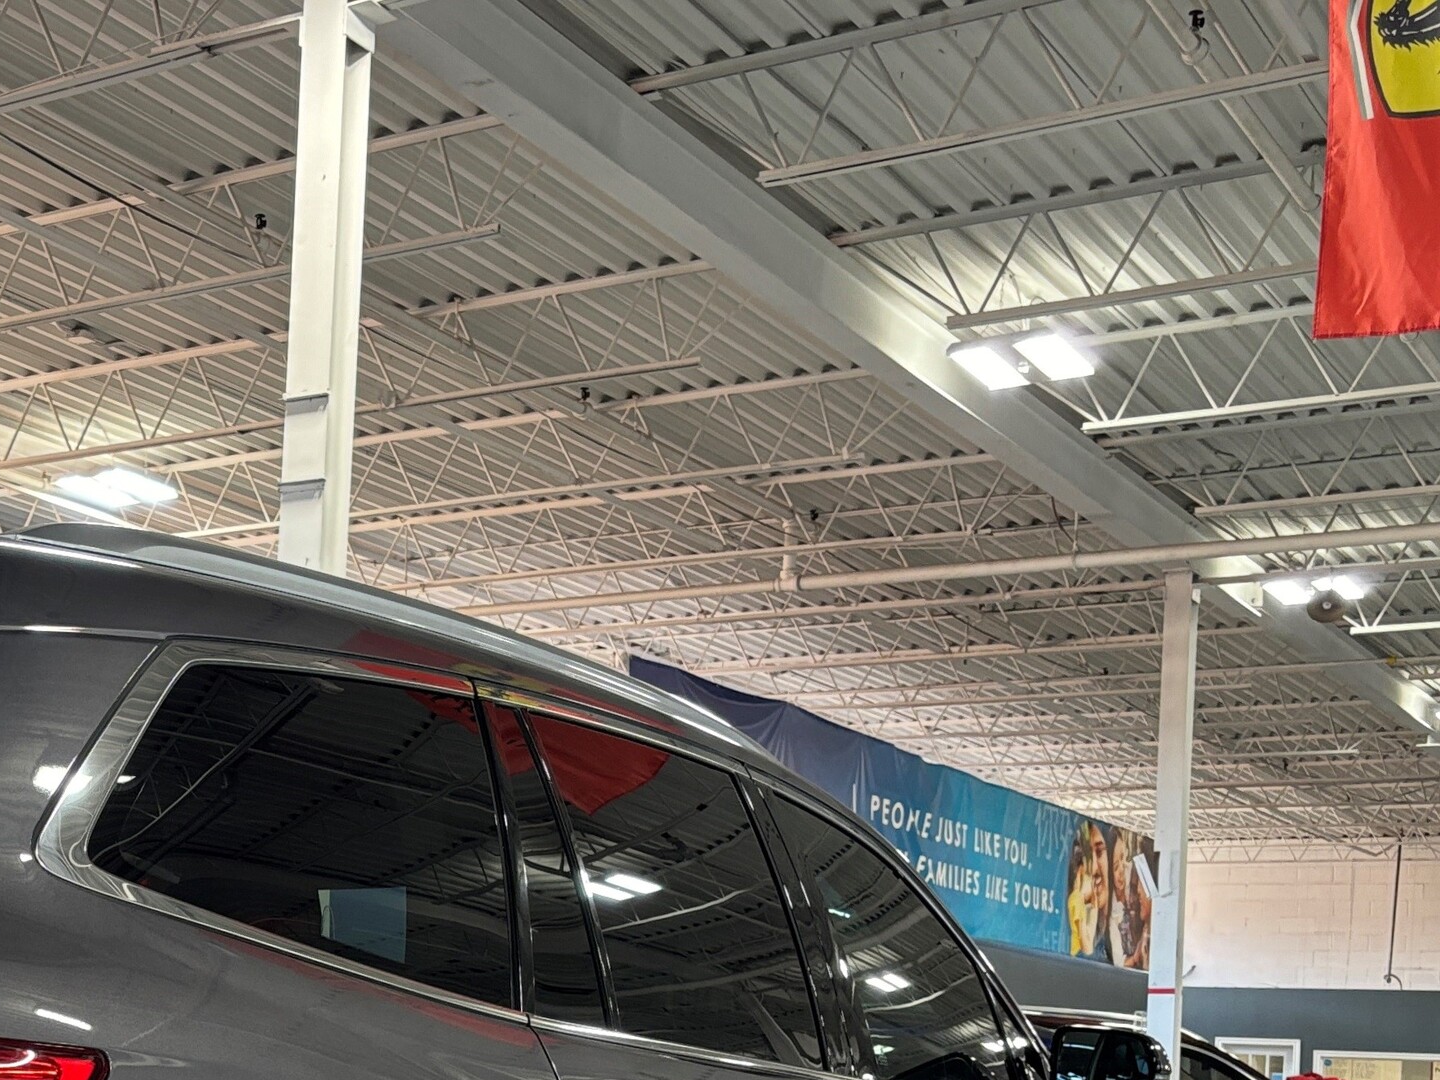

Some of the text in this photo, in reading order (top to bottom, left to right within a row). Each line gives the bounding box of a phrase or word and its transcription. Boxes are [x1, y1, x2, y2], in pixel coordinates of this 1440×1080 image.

[935, 816, 968, 849] JUST
[973, 827, 1002, 858] LIKE
[1003, 836, 1033, 870] YOU,
[916, 854, 1060, 915] FAMILIES LIKE YOURS.
